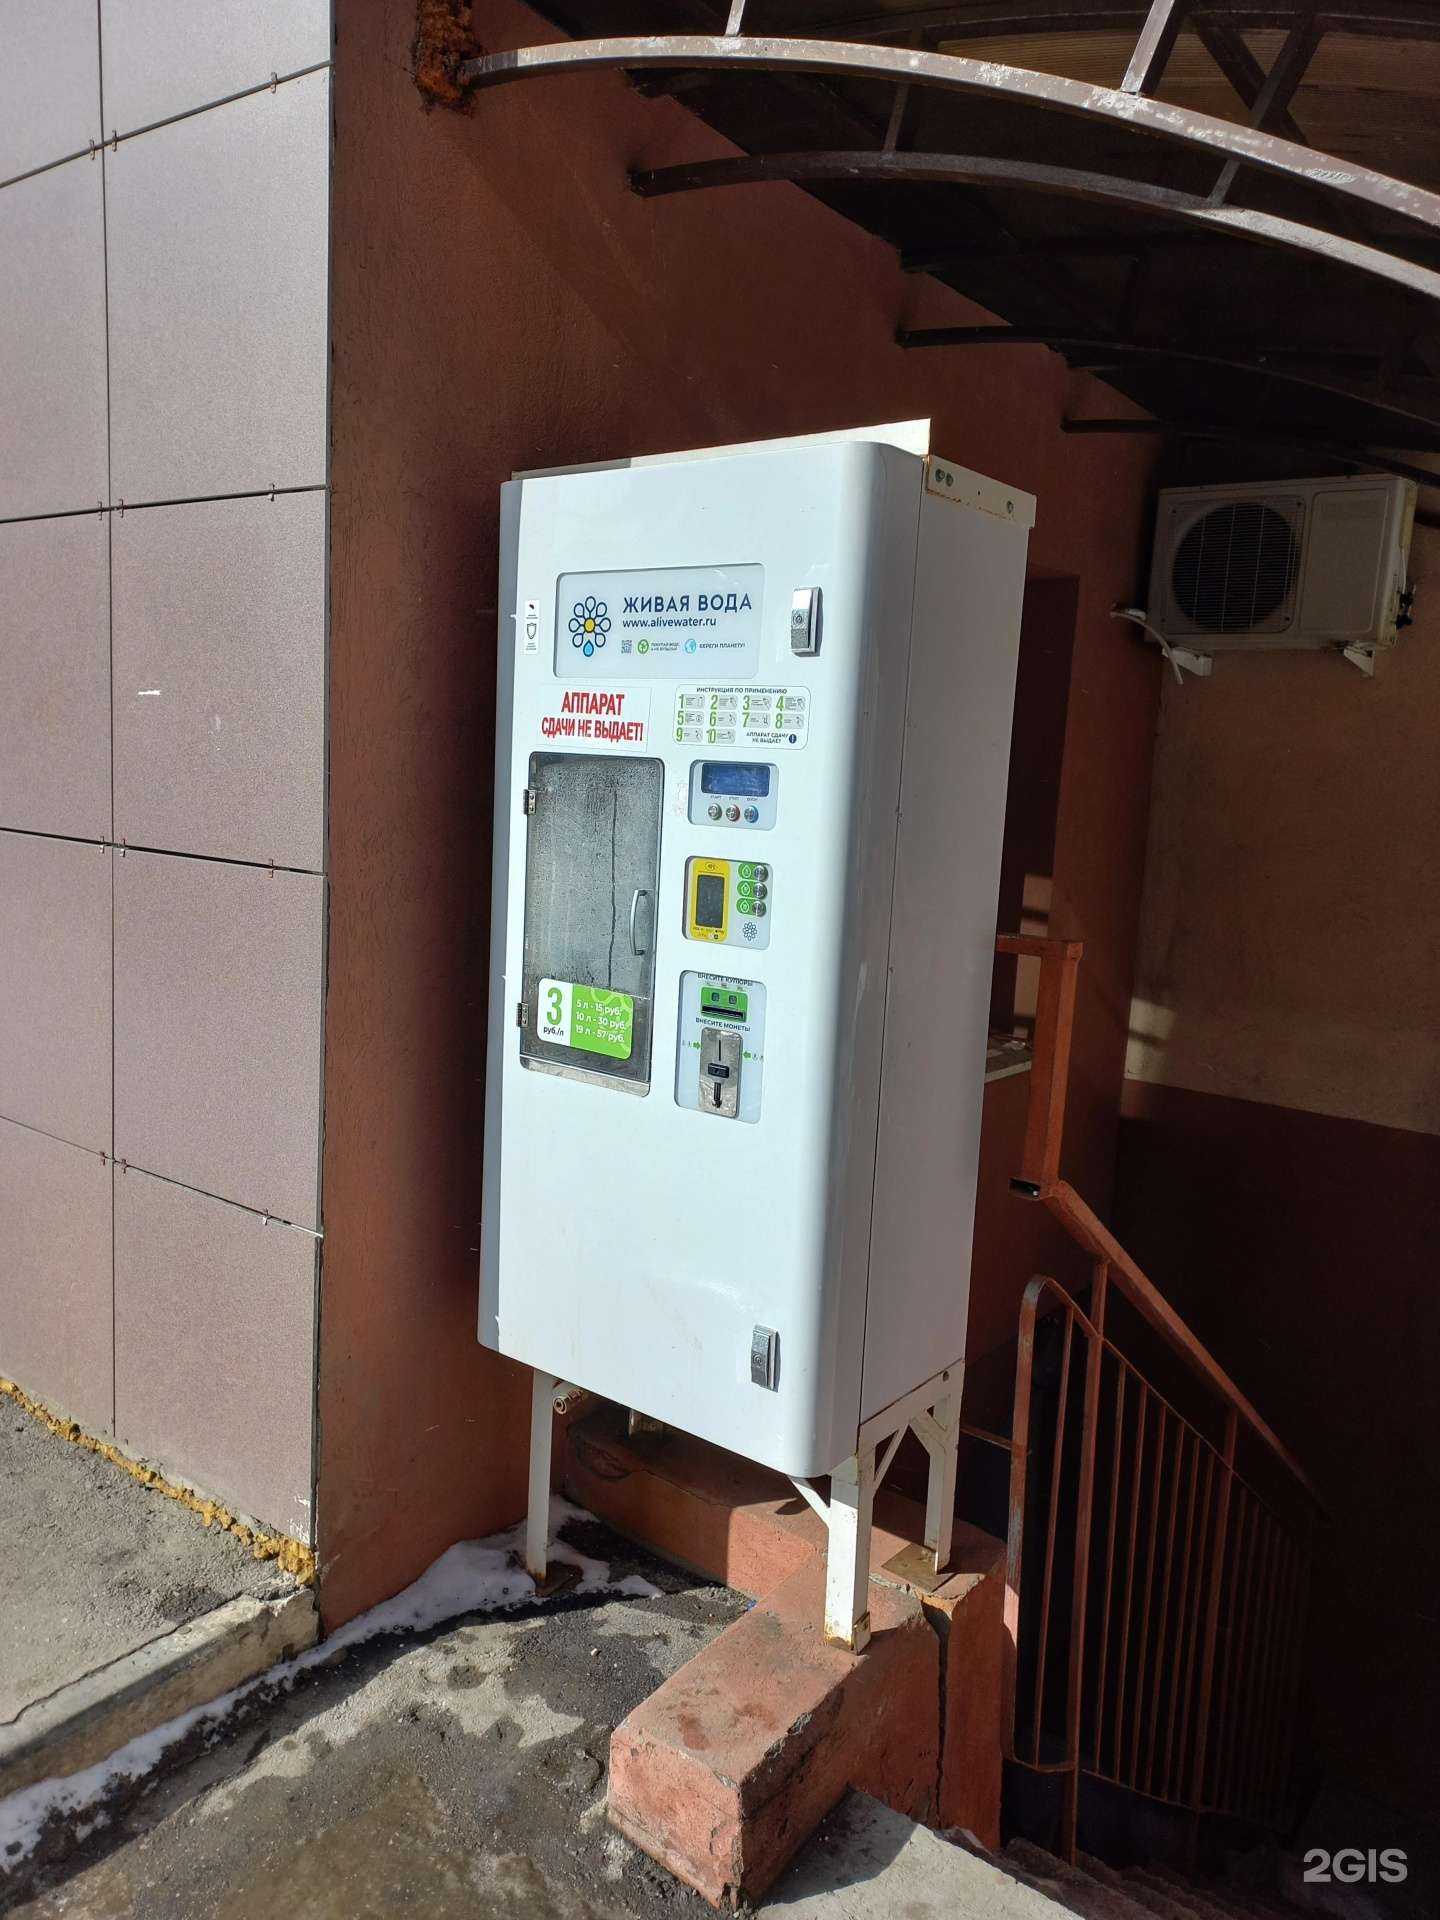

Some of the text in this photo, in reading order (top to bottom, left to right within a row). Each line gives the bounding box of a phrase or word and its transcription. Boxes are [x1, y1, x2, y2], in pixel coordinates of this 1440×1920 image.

[622, 593, 752, 613] ЖИВАЯ ВОДА
[622, 617, 717, 628] www.alivewater.ru
[561, 691, 625, 716] АППАРАТ
[678, 694, 685, 709] 1
[710, 694, 718, 710] 2
[742, 695, 751, 711] 3
[775, 696, 784, 712] 4
[677, 710, 684, 726] 5
[709, 711, 717, 727] 6
[742, 712, 750, 728] 7
[775, 713, 783, 729] 8
[541, 717, 644, 743] СДАЧИ НЕ ВЫДАЕТ!
[676, 727, 683, 742] 9
[706, 728, 716, 743] 10
[546, 987, 562, 1025] 3
[576, 999, 582, 1008] 5
[595, 1003, 603, 1013] 15
[576, 1011, 584, 1021] 10
[586, 1015, 591, 1023] л
[598, 1017, 608, 1026] 30
[695, 1017, 751, 1032] ВНЕСИТЕ МОНЕТЫ
[543, 1026, 564, 1037] руб./л
[576, 1024, 584, 1034] 19
[596, 1029, 606, 1038] 57
